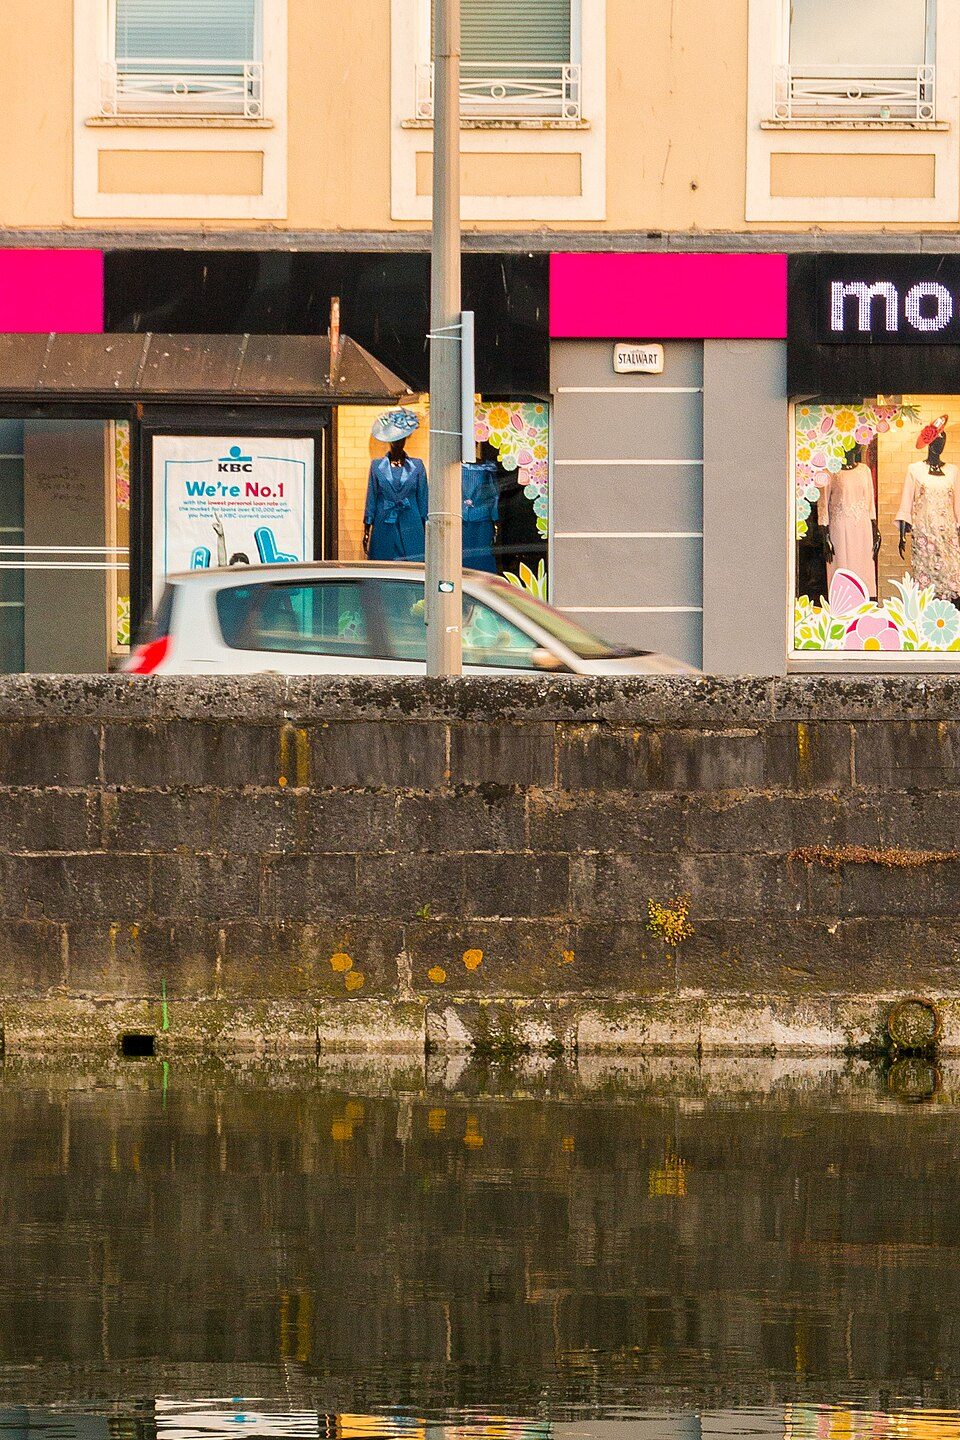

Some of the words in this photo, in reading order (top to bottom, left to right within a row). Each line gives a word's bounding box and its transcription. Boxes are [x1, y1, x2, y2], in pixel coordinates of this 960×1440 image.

[618, 353, 658, 365] STALWART
[218, 463, 253, 473] KBC
[245, 482, 284, 498] No.1
